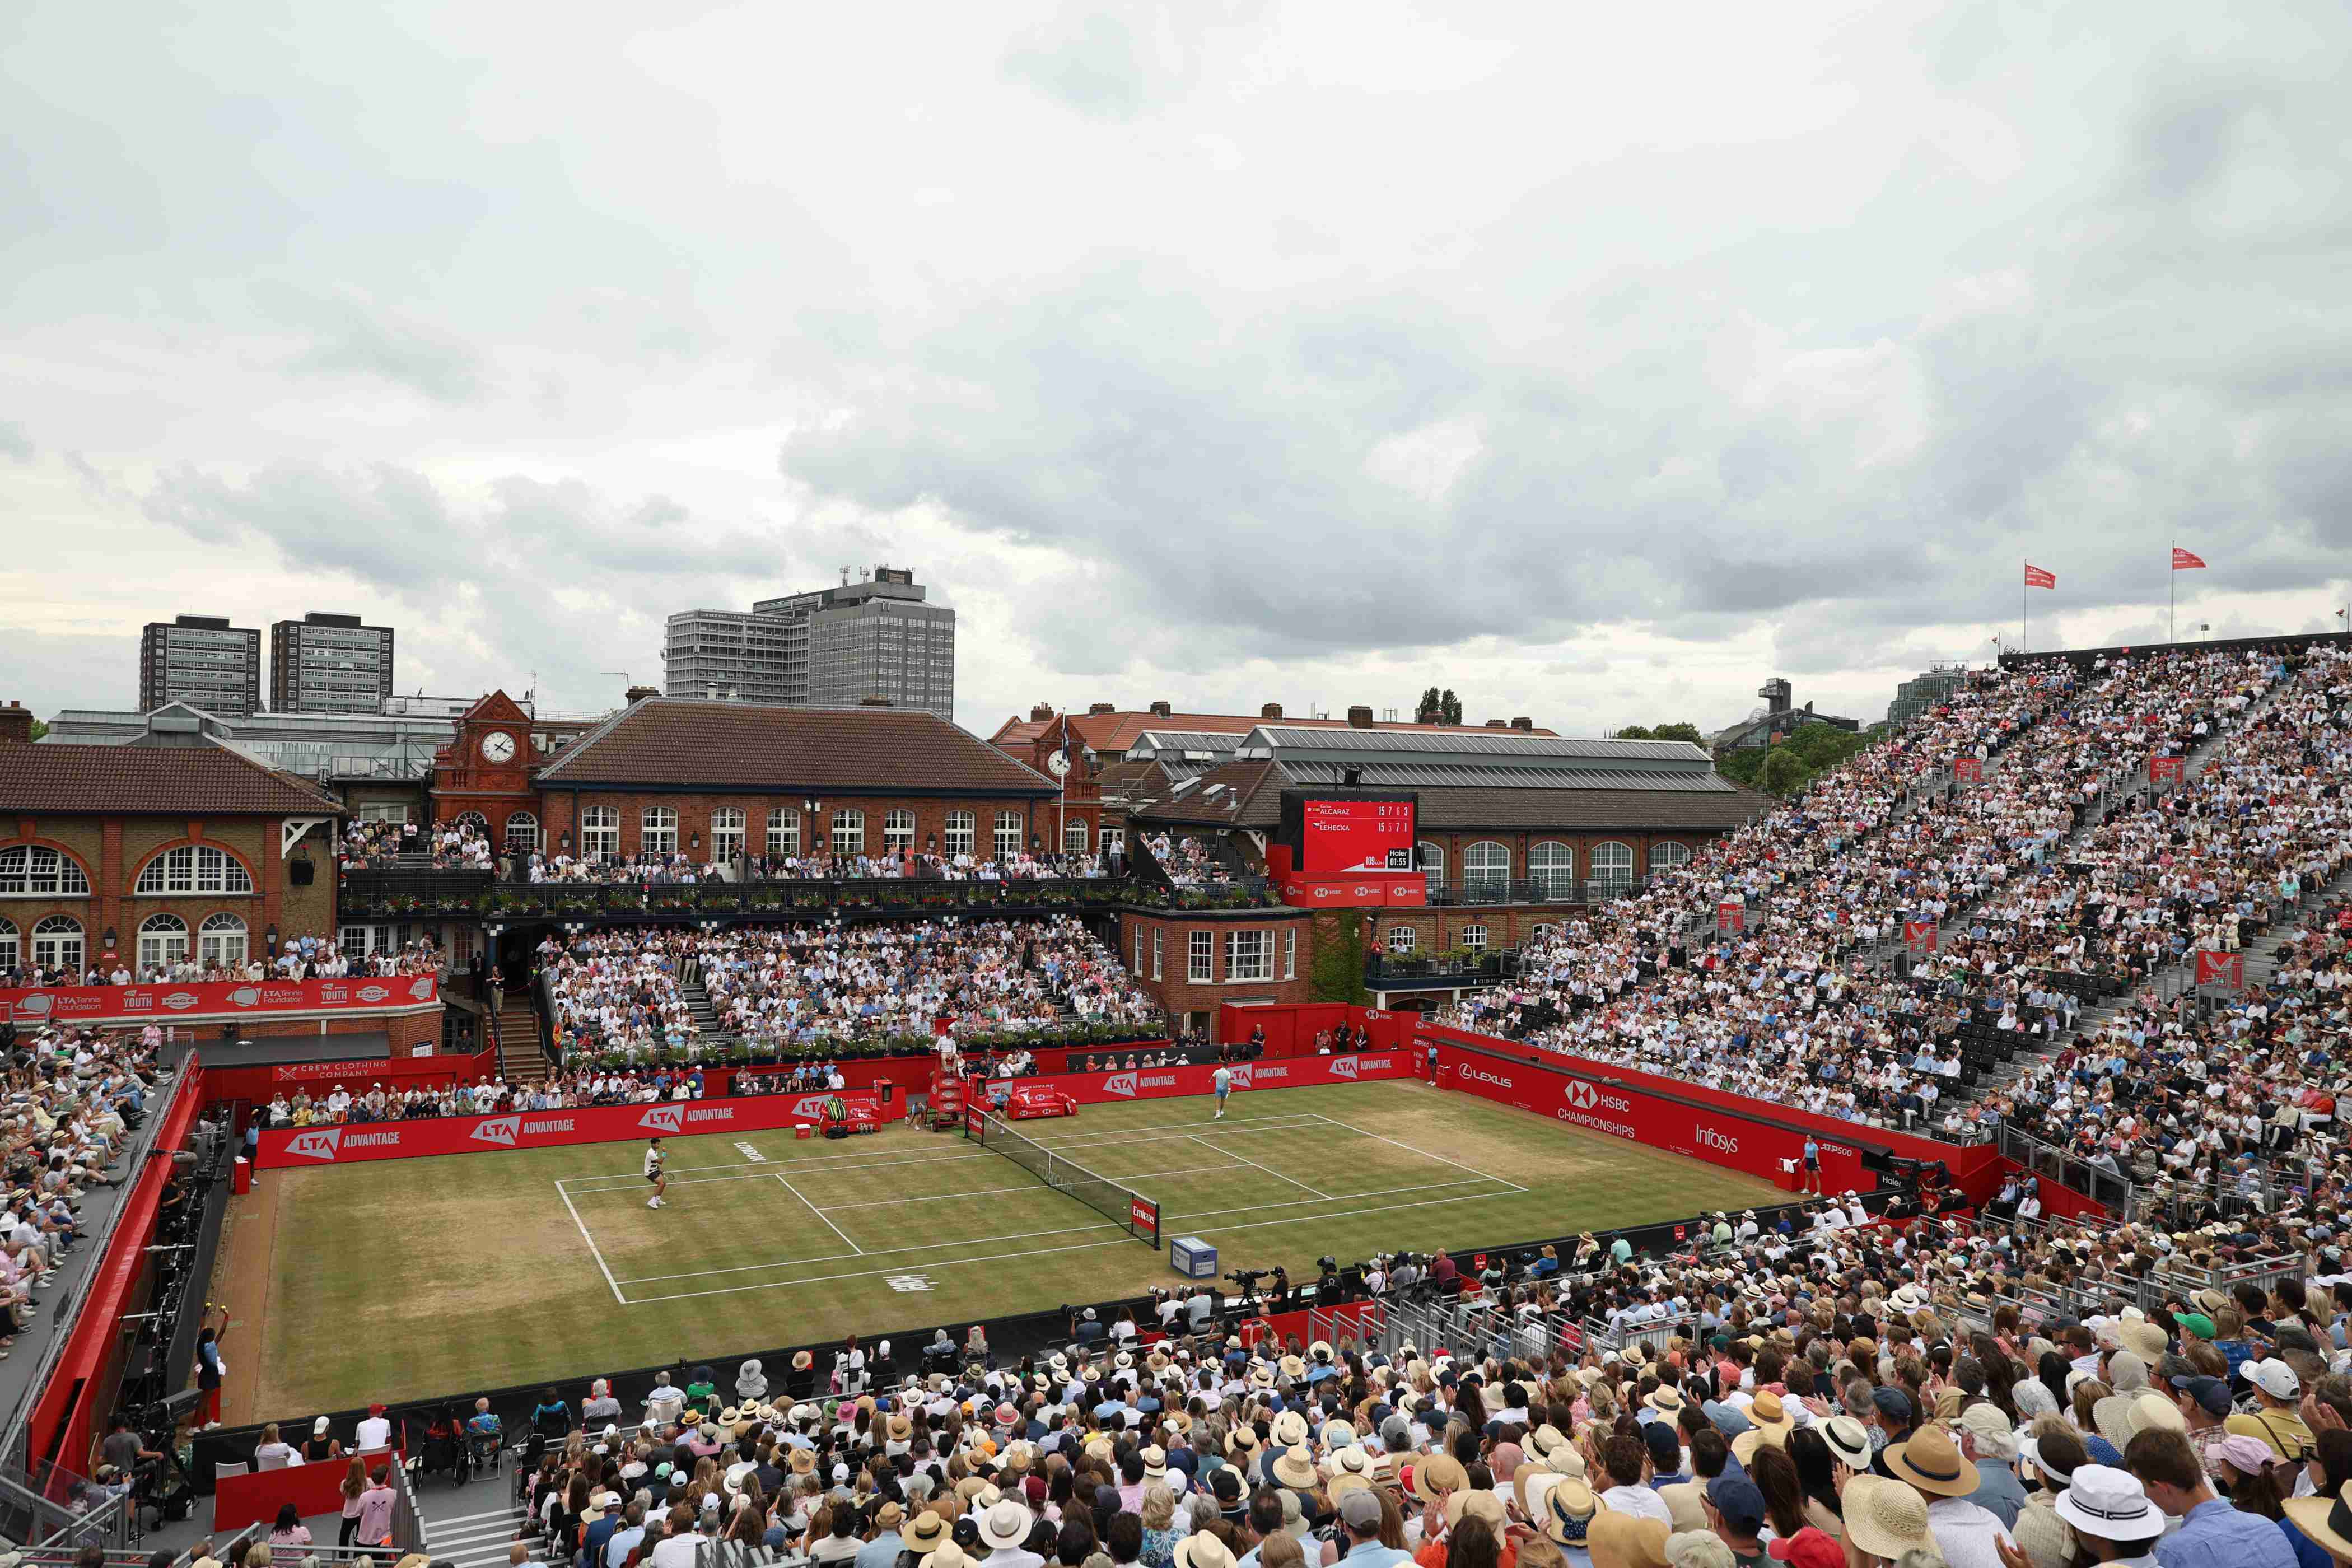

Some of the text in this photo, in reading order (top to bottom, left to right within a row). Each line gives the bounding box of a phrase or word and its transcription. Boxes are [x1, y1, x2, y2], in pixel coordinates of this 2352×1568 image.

[1379, 806, 1384, 815] 15
[1389, 807, 1392, 815] 7
[1397, 807, 1400, 815] 6
[1404, 807, 1408, 816] 3
[1379, 823, 1384, 832] 15
[1389, 823, 1392, 832] 5
[1396, 823, 1399, 832] 7
[1404, 823, 1407, 832] 1
[1366, 856, 1375, 865] 109
[321, 990, 347, 1000] YOUTH
[123, 997, 152, 1007] YOUTH
[335, 1061, 387, 1070] CLOTHING
[1360, 1059, 1392, 1071] ADVANTAGE
[319, 1070, 369, 1079] COMPANY
[1254, 1066, 1289, 1079] ADVANTAGE
[1473, 1070, 1512, 1088] LEXUS
[1140, 1075, 1175, 1088] ADVANTAGE
[1600, 1094, 1630, 1113] HSBC
[687, 1107, 734, 1122] ADVANTAGE
[524, 1119, 575, 1135] ADVANTAGE
[1558, 1107, 1635, 1138] CHAMPIONSHIPS
[344, 1131, 400, 1148] ADVANTAGE
[1696, 1123, 1738, 1154] Infosys
[1821, 1142, 1852, 1157] ATP500
[1882, 1175, 1902, 1187] Haier
[1133, 1205, 1155, 1225] Emirates
